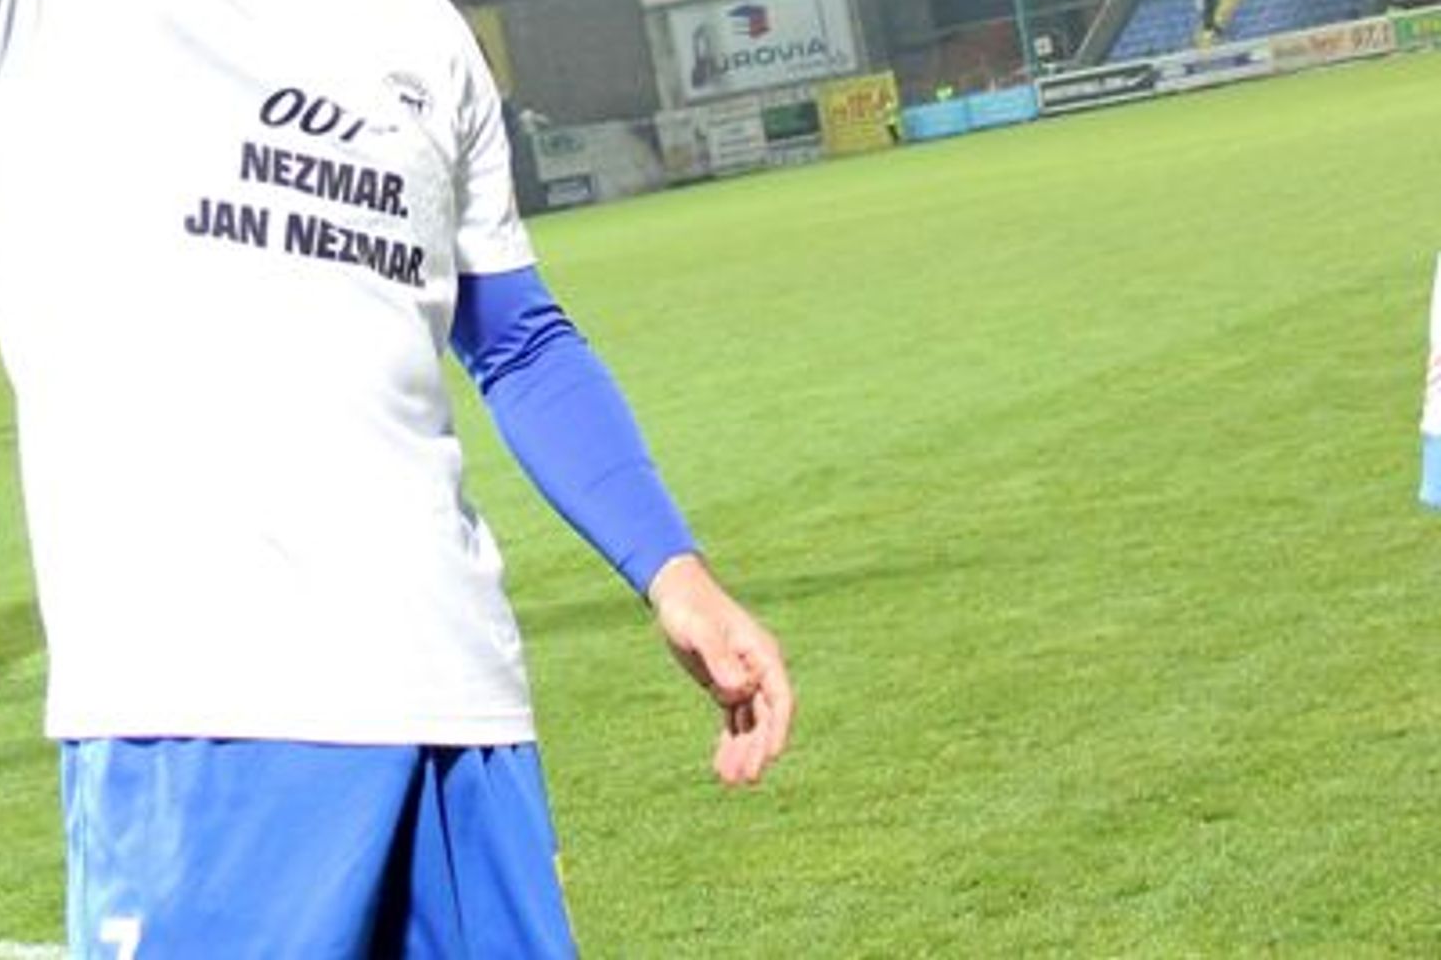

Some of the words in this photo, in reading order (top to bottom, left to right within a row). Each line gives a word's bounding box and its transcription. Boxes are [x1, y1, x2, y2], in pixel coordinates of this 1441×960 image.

[709, 37, 827, 76] UROVIA
[240, 141, 408, 217] NEZMAR.
[184, 197, 269, 248] JAN
[100, 918, 141, 960] 7
